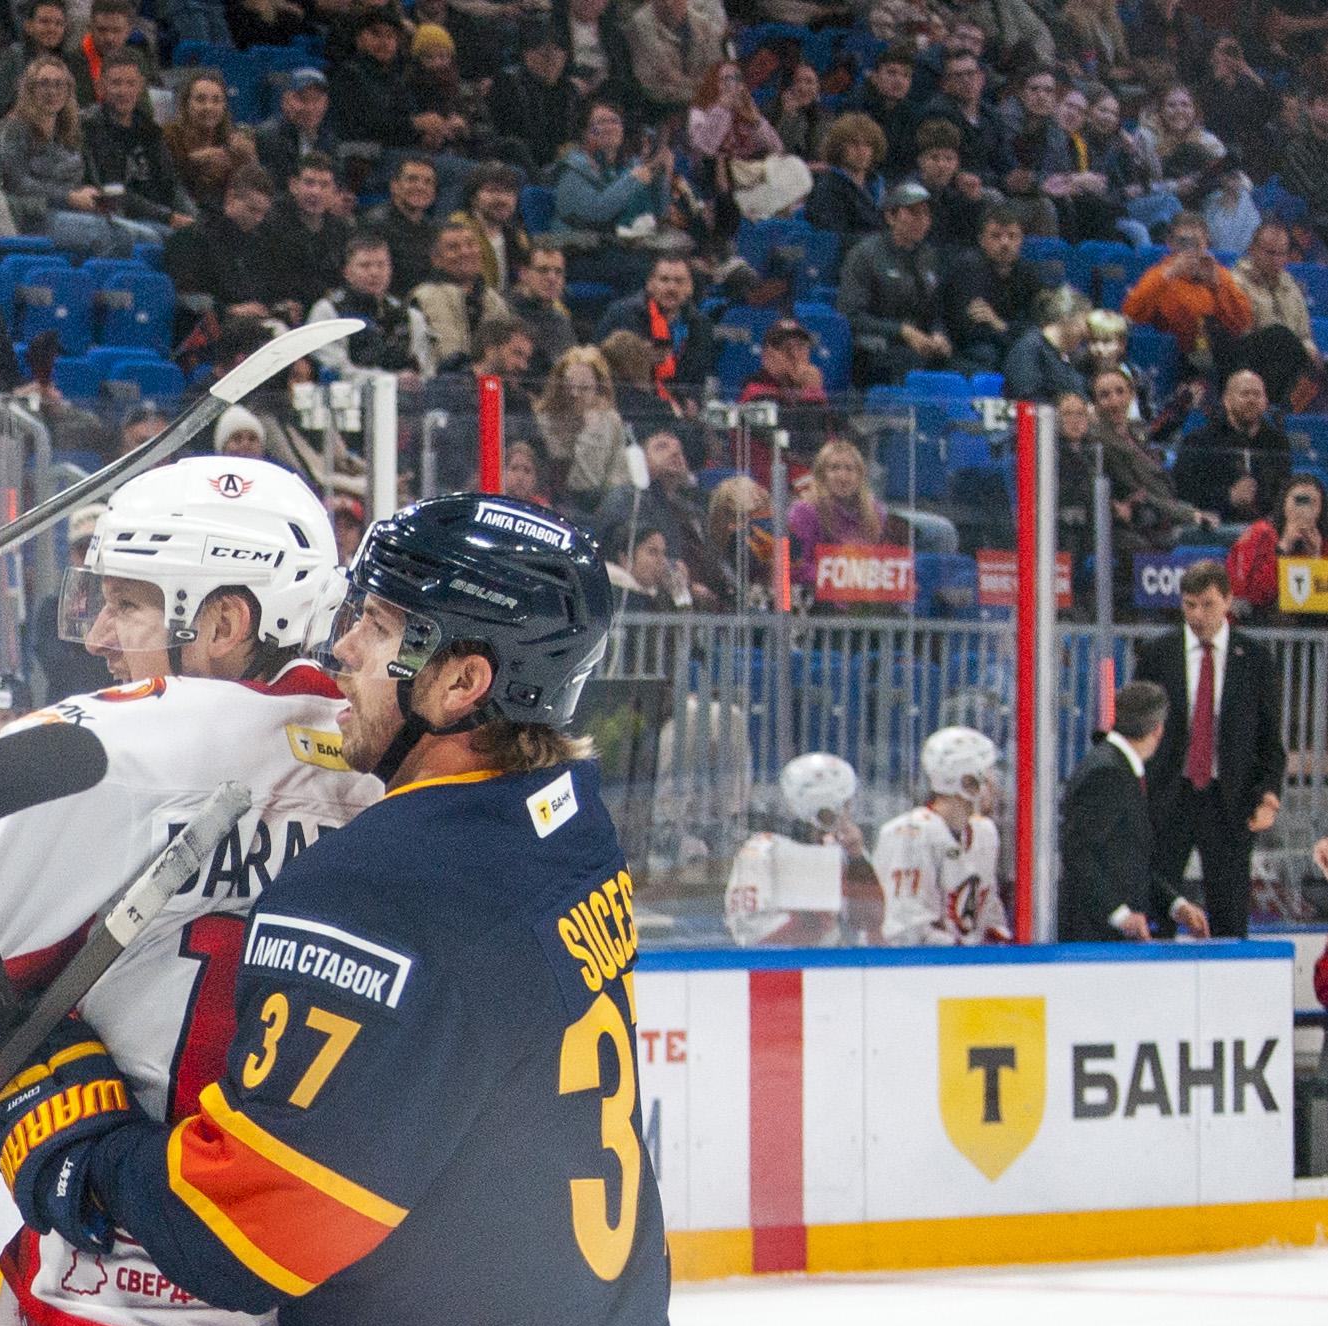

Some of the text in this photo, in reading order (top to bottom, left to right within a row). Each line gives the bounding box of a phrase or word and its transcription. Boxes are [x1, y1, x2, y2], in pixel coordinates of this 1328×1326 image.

[483, 511, 563, 547] ЛИГА СТАВОК
[210, 546, 273, 562] CCM
[816, 555, 913, 592] FONBET
[550, 789, 572, 814] БАНК
[252, 935, 391, 1003] ЛИГА СТАВОК
[243, 992, 363, 1110] 37
[1071, 1037, 1280, 1121] БАНК
[6, 1085, 40, 1112] COVERT
